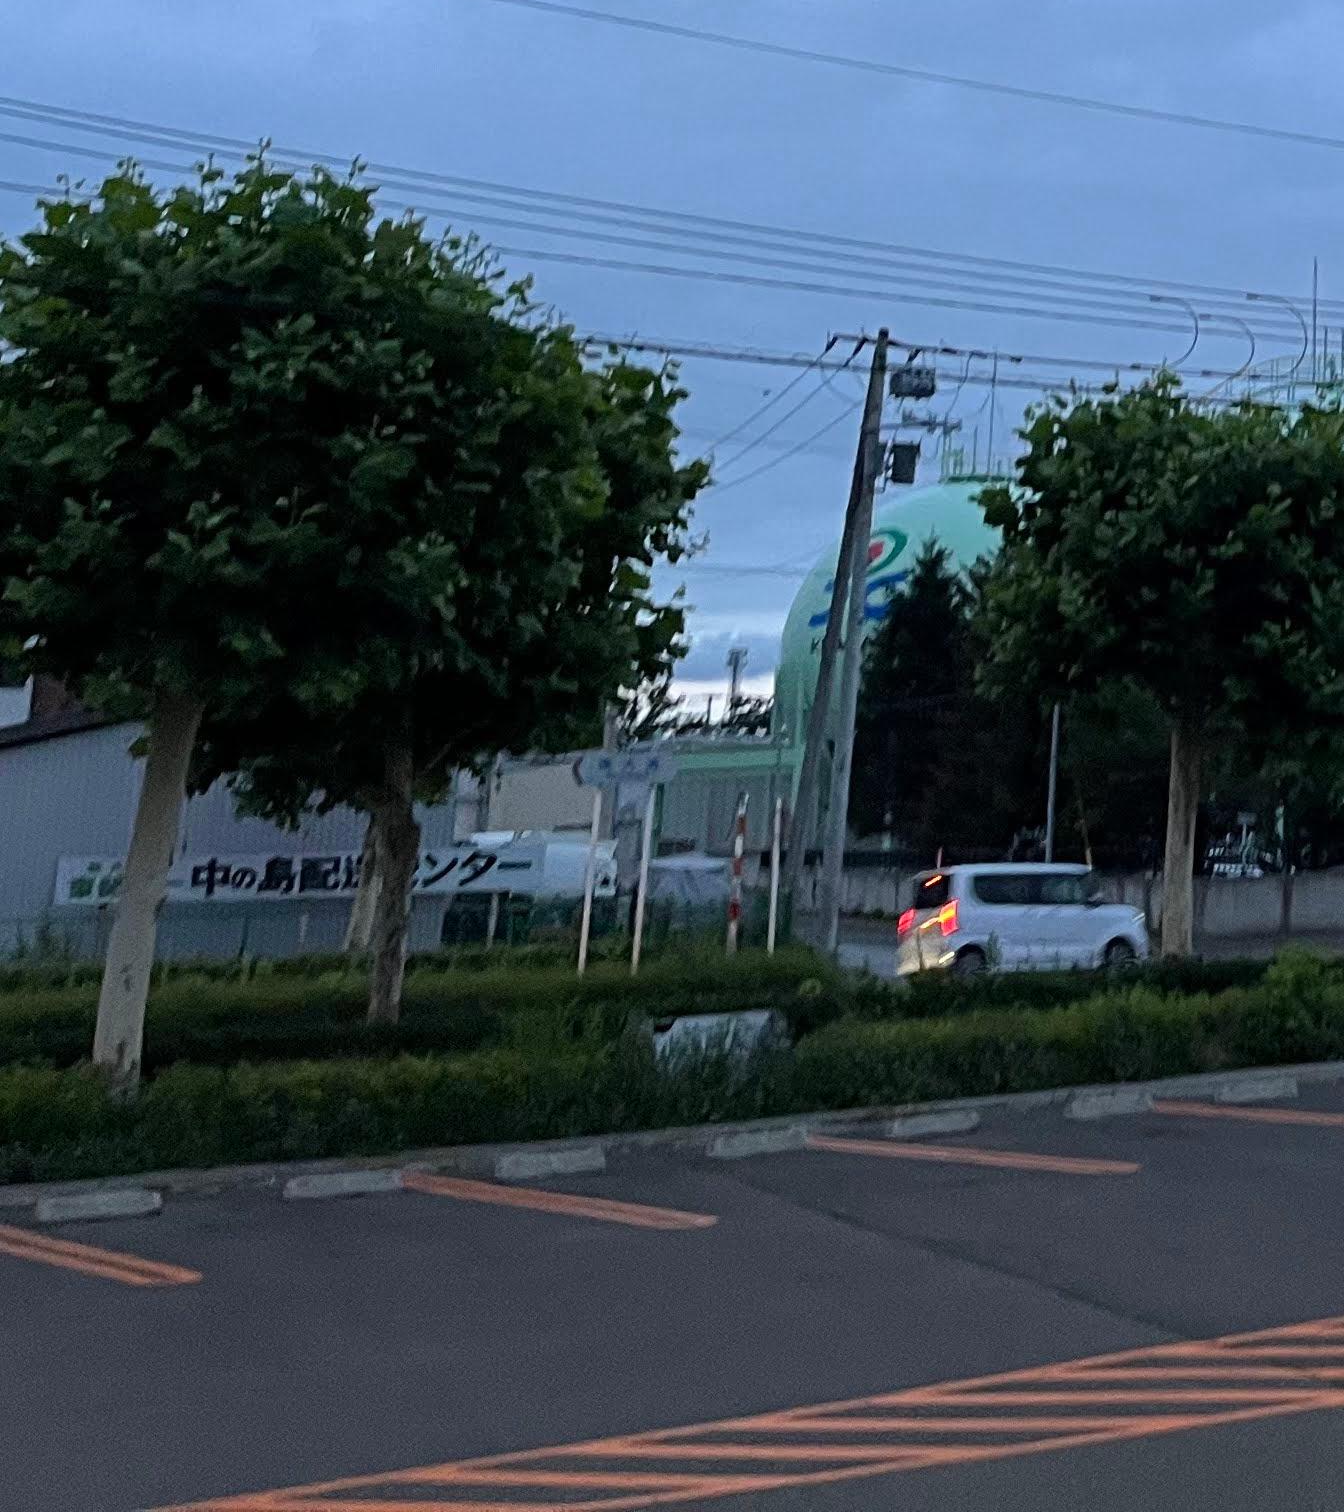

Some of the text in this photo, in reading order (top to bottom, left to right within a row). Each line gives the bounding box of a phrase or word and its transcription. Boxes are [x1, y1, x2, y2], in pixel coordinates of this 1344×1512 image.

[190, 851, 533, 895] 中の島配ンター
